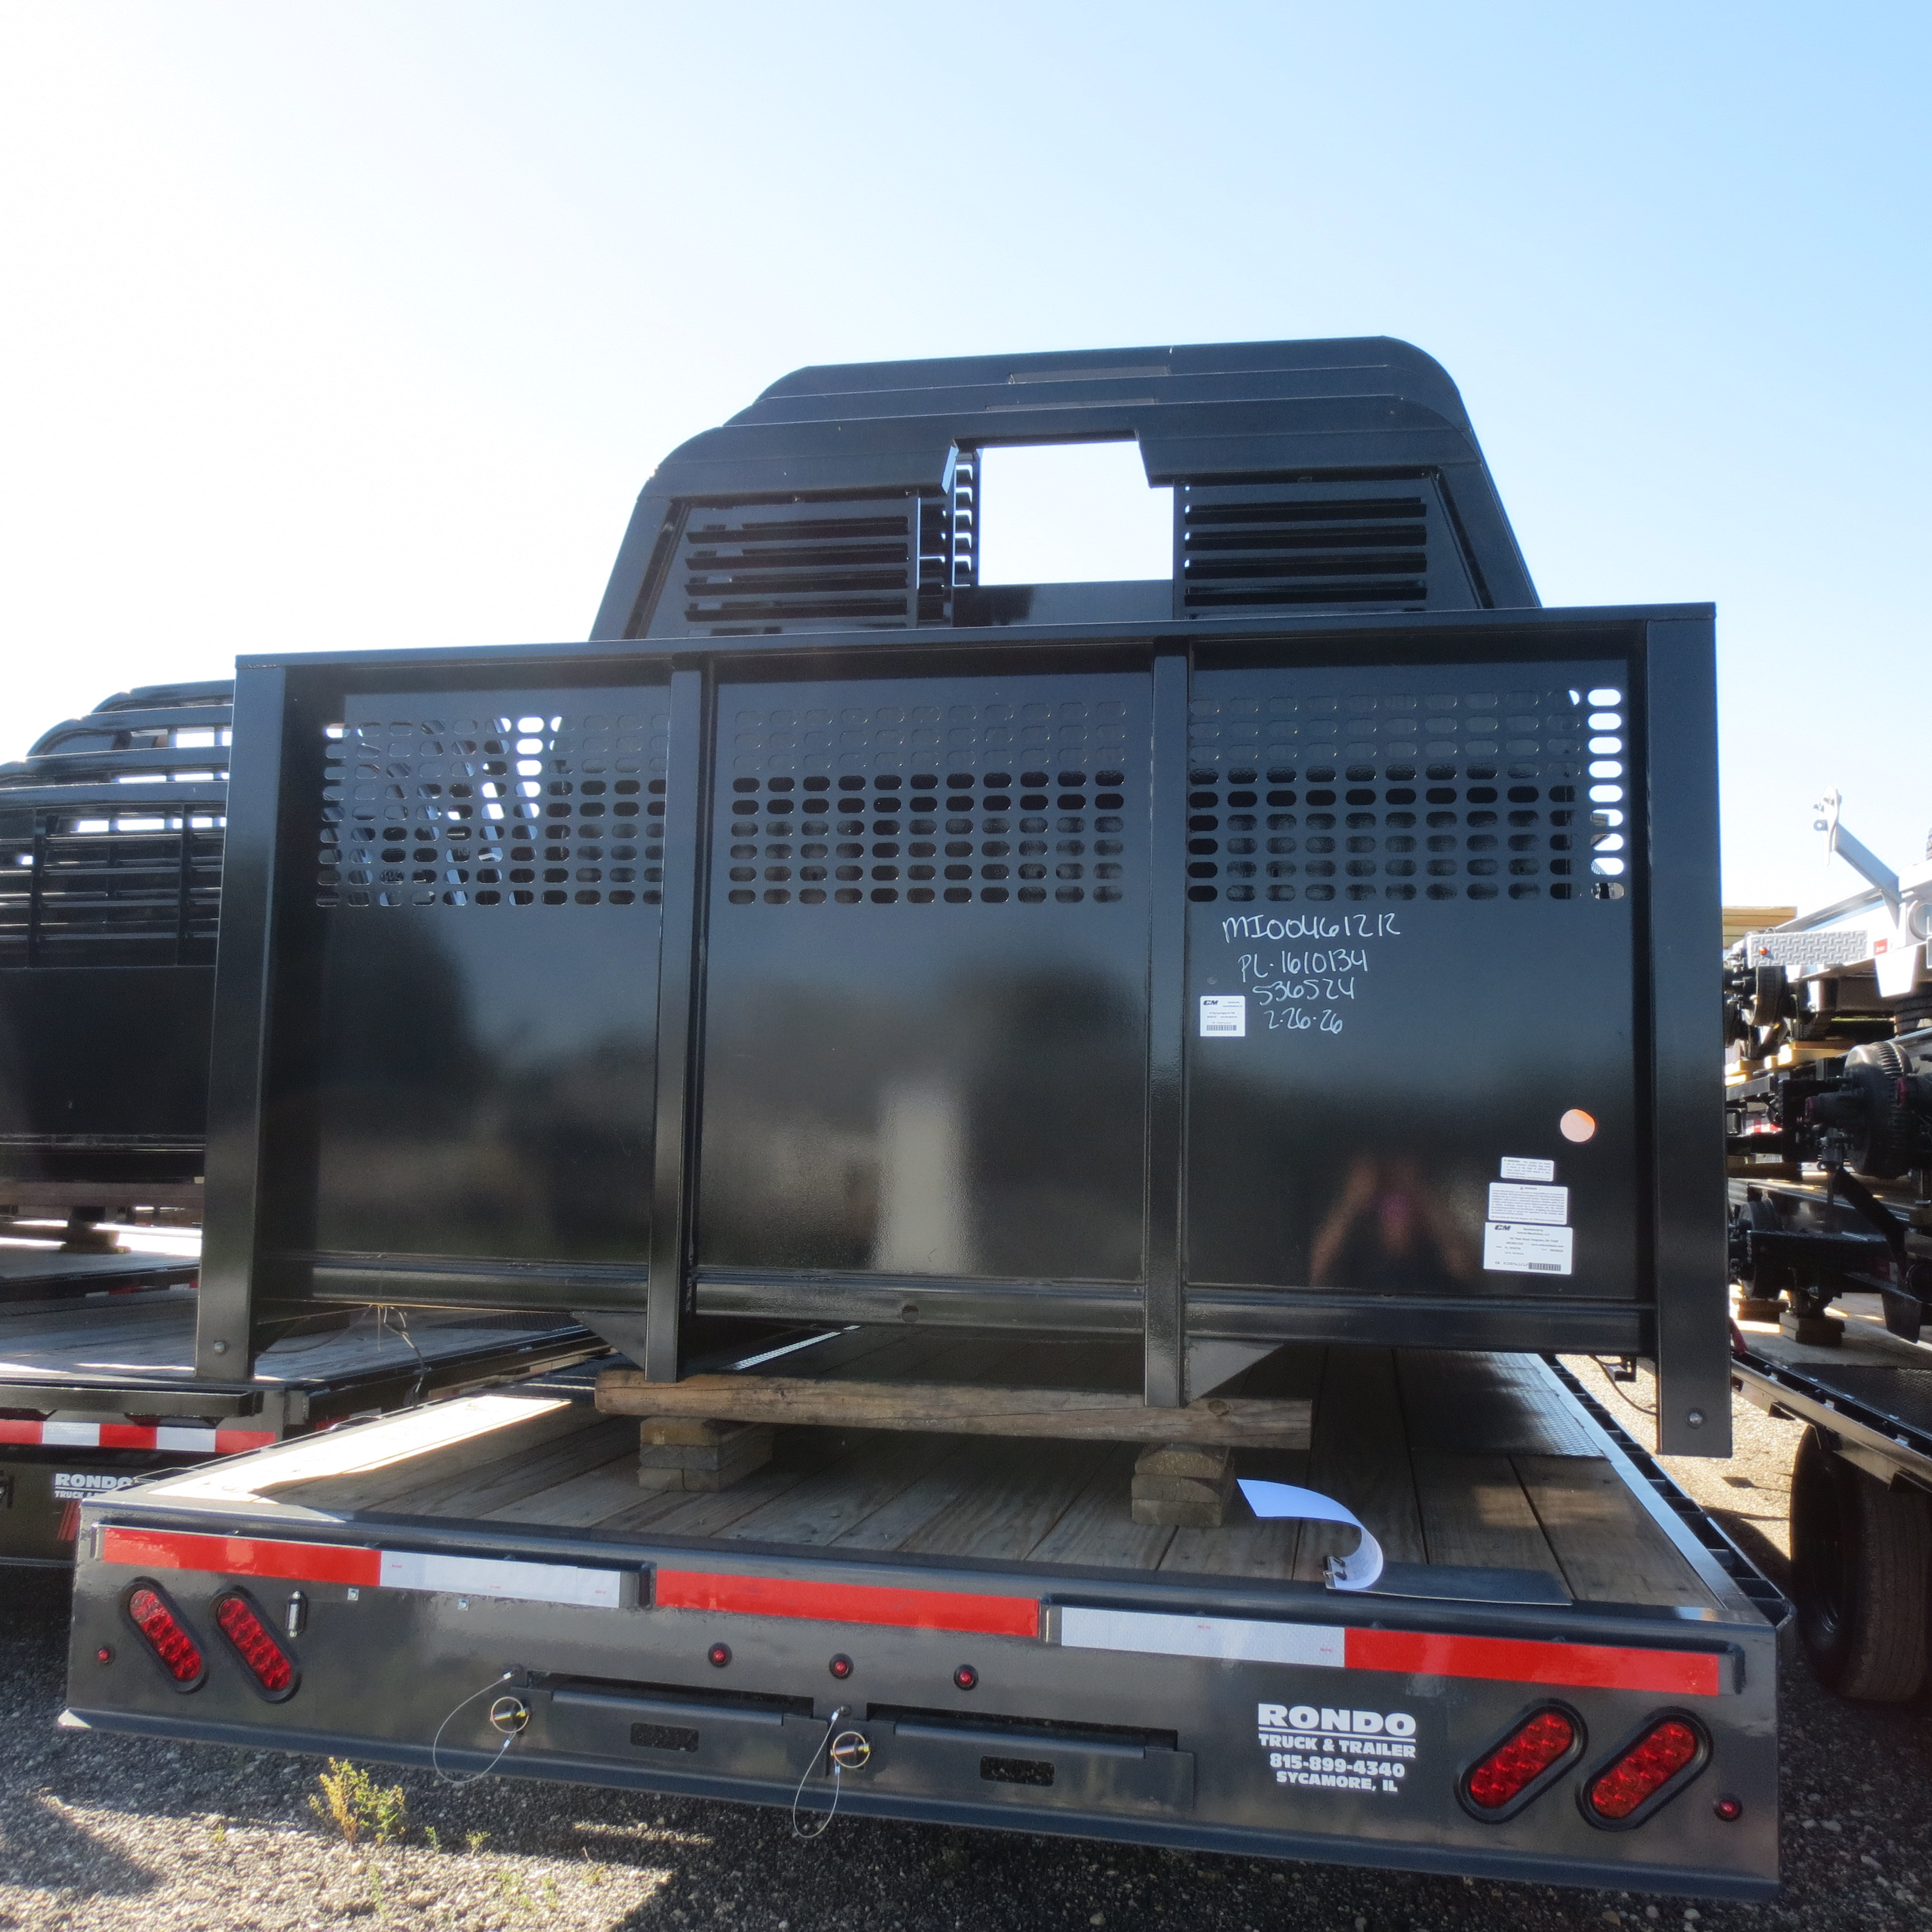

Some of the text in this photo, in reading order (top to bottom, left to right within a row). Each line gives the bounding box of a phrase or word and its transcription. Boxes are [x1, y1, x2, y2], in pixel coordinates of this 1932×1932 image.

[1258, 1703, 1416, 1736] RONDO
[1258, 1733, 1416, 1758] TRUCK & TRAILER
[1270, 1753, 1405, 1778] 815-899-4340
[1276, 1771, 1398, 1792] SYCAMORE, IL
